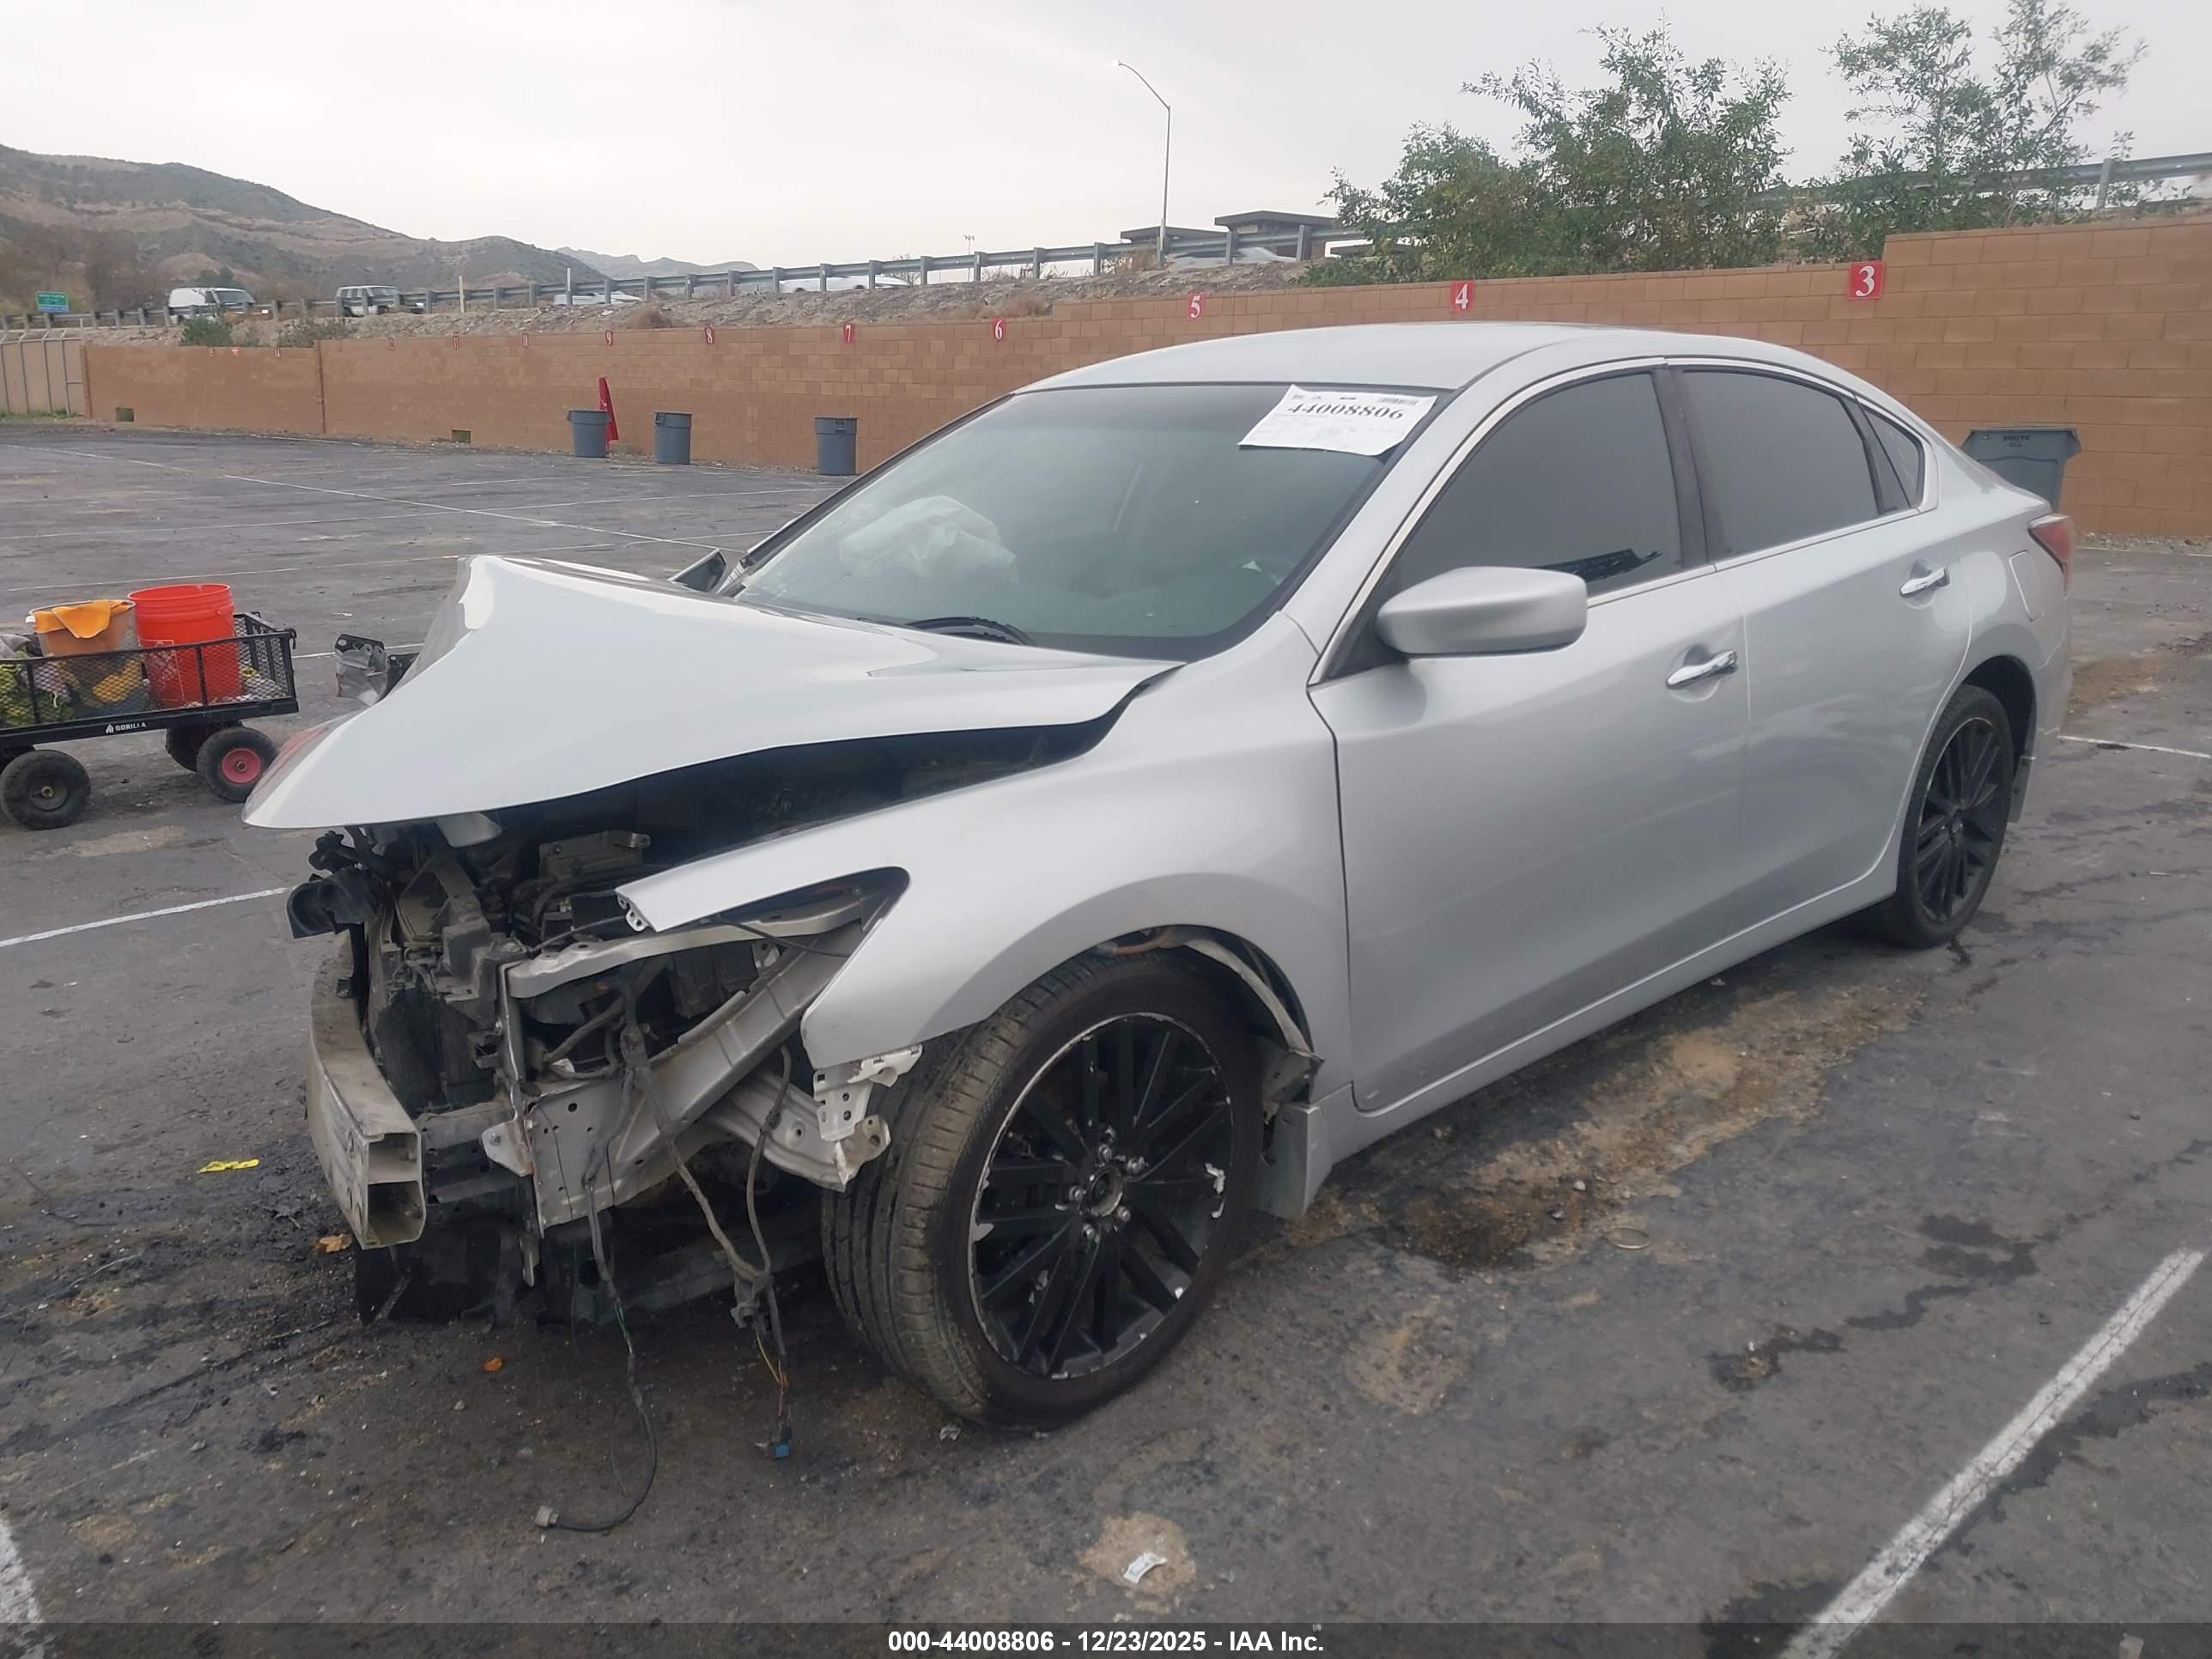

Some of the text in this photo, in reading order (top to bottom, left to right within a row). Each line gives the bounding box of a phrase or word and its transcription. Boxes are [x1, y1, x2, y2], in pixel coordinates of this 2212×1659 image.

[1856, 265, 1875, 297] 3
[1455, 283, 1468, 309] 4
[1189, 295, 1201, 318] 5
[605, 331, 612, 345] 9
[706, 328, 714, 344] 8
[845, 324, 852, 343] 7
[994, 319, 1003, 340] 6
[1287, 404, 1404, 420] 44008806
